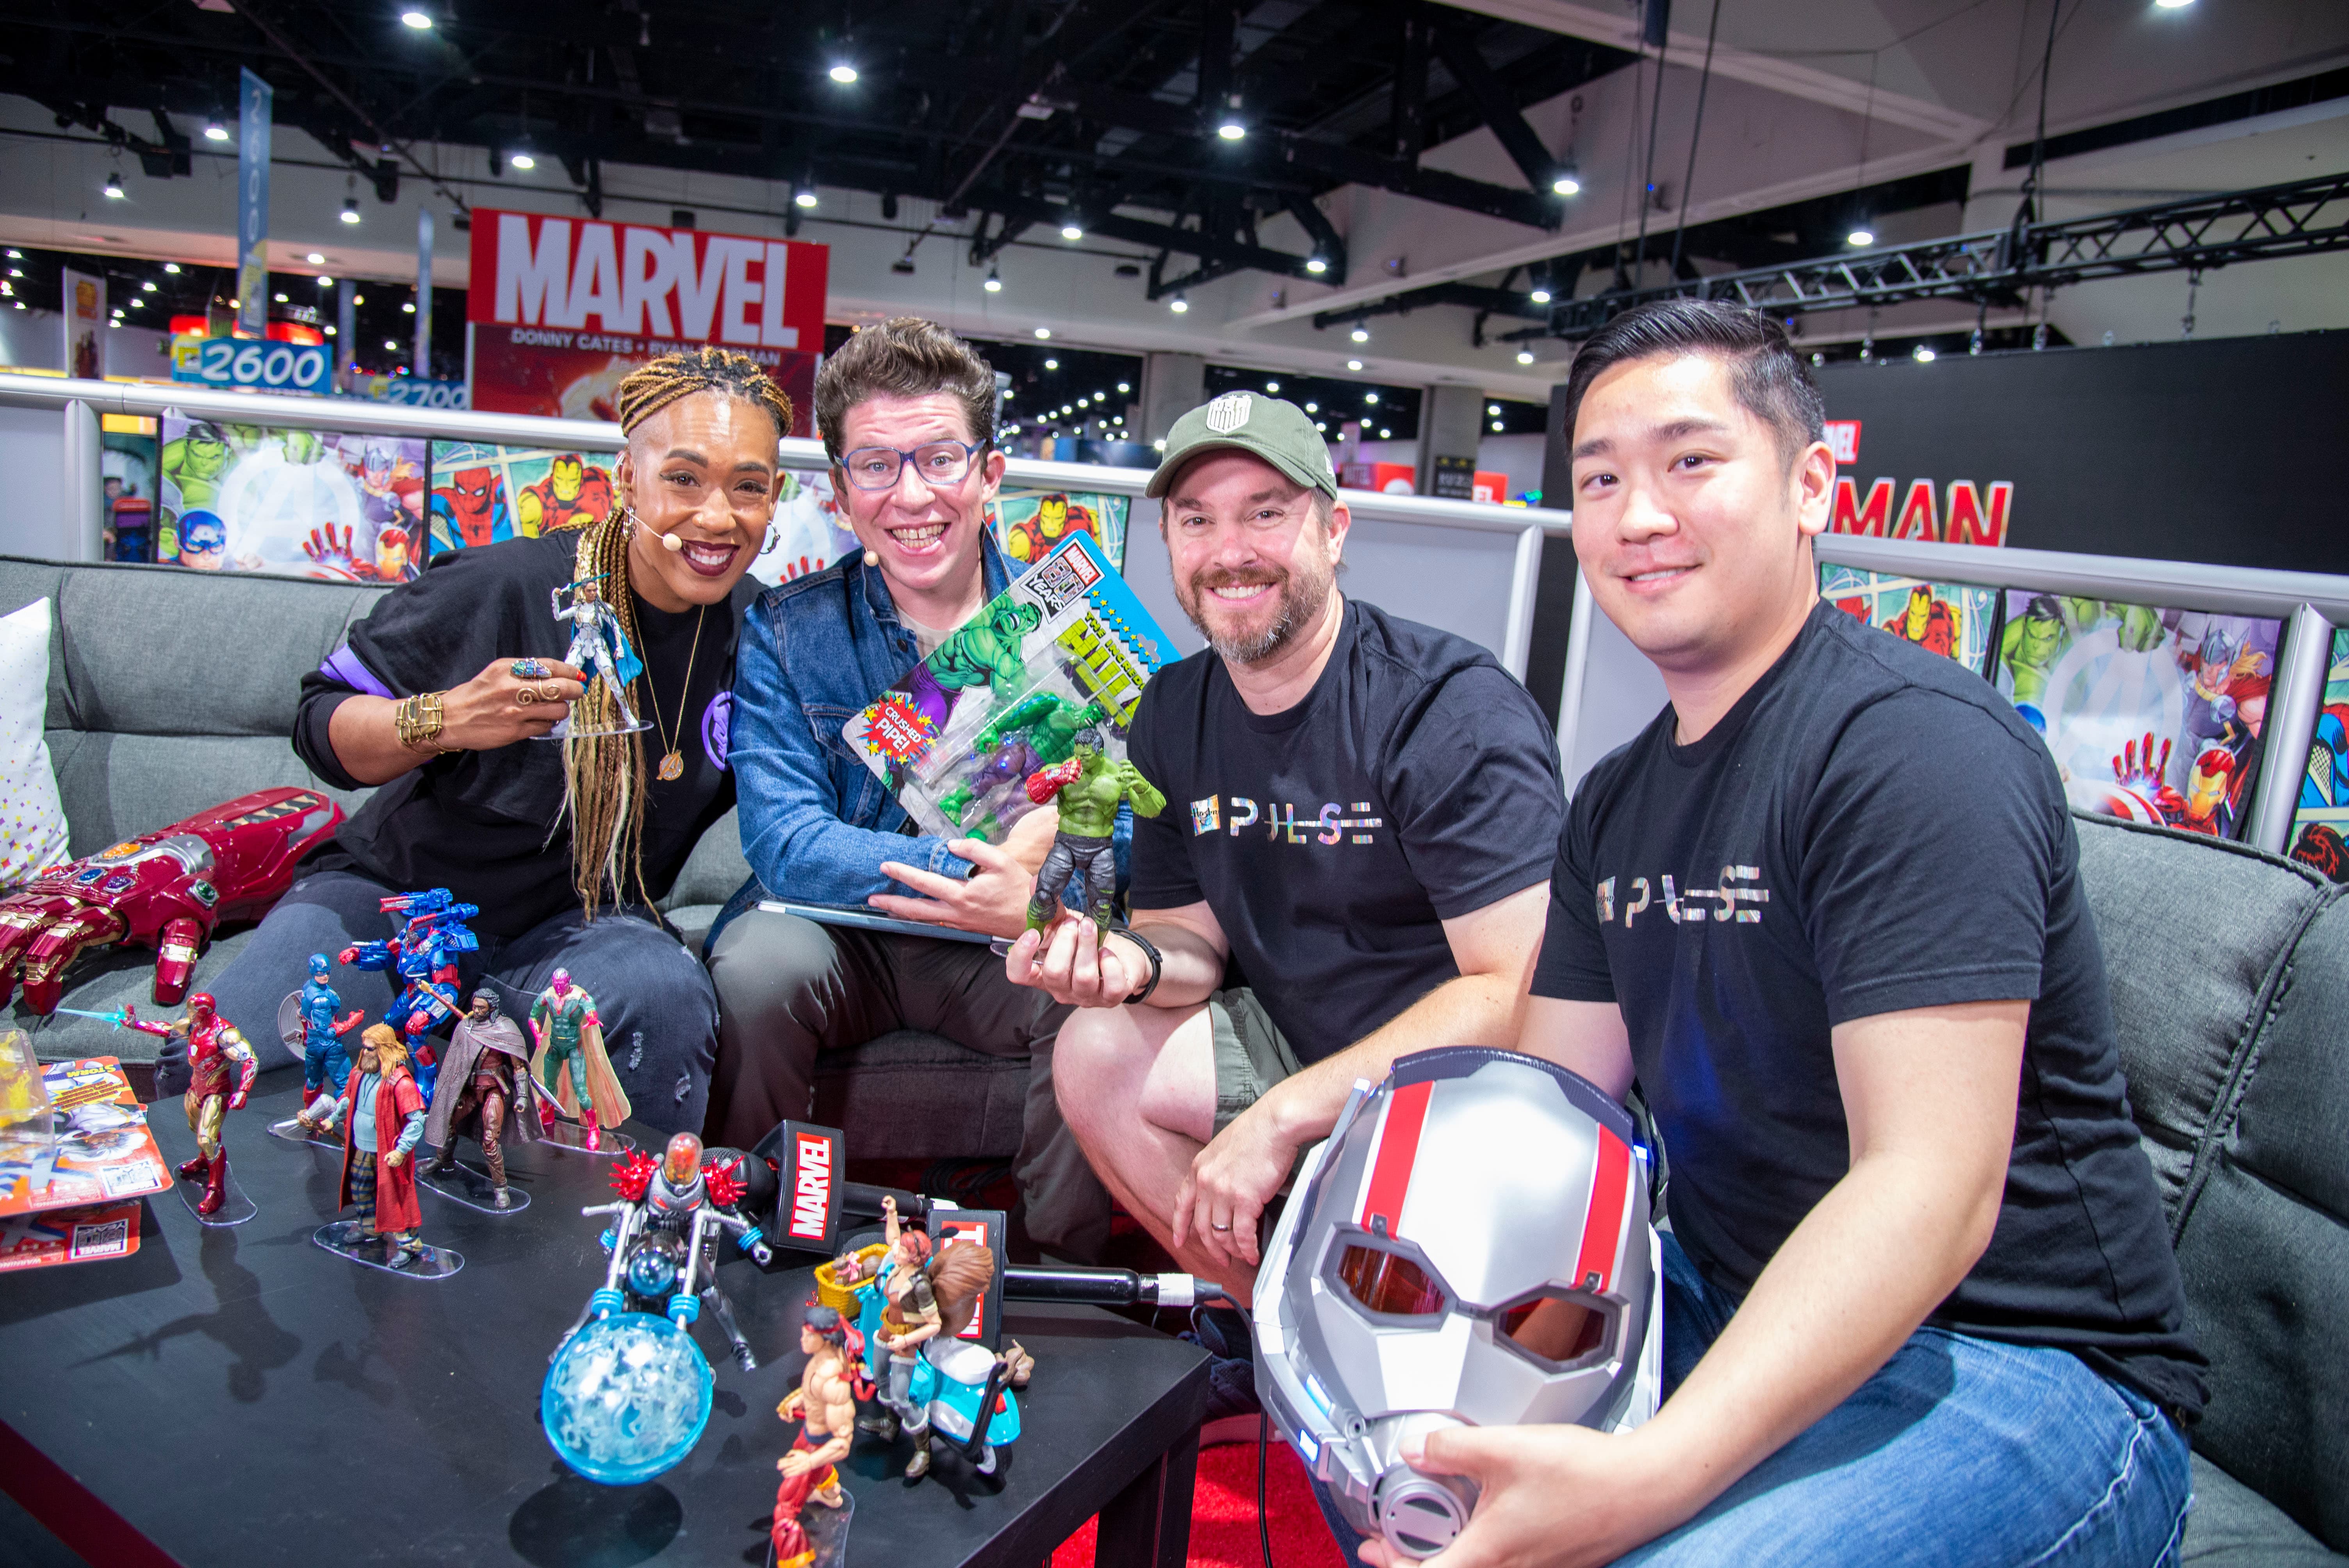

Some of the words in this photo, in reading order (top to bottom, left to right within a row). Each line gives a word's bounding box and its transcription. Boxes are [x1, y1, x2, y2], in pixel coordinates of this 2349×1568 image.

[494, 213, 799, 349] MARVEL
[511, 327, 574, 348] DONNY
[577, 333, 633, 353] CATES
[201, 343, 324, 387] 2600
[391, 383, 468, 410] 2700
[1041, 556, 1085, 604] 80
[1064, 546, 1096, 584] MARVEL
[1029, 573, 1066, 611] YEARS
[1085, 611, 1106, 638] THE
[875, 717, 911, 753] PIPE!
[884, 706, 921, 743] CRUSHED
[792, 1139, 829, 1237] MARVEL
